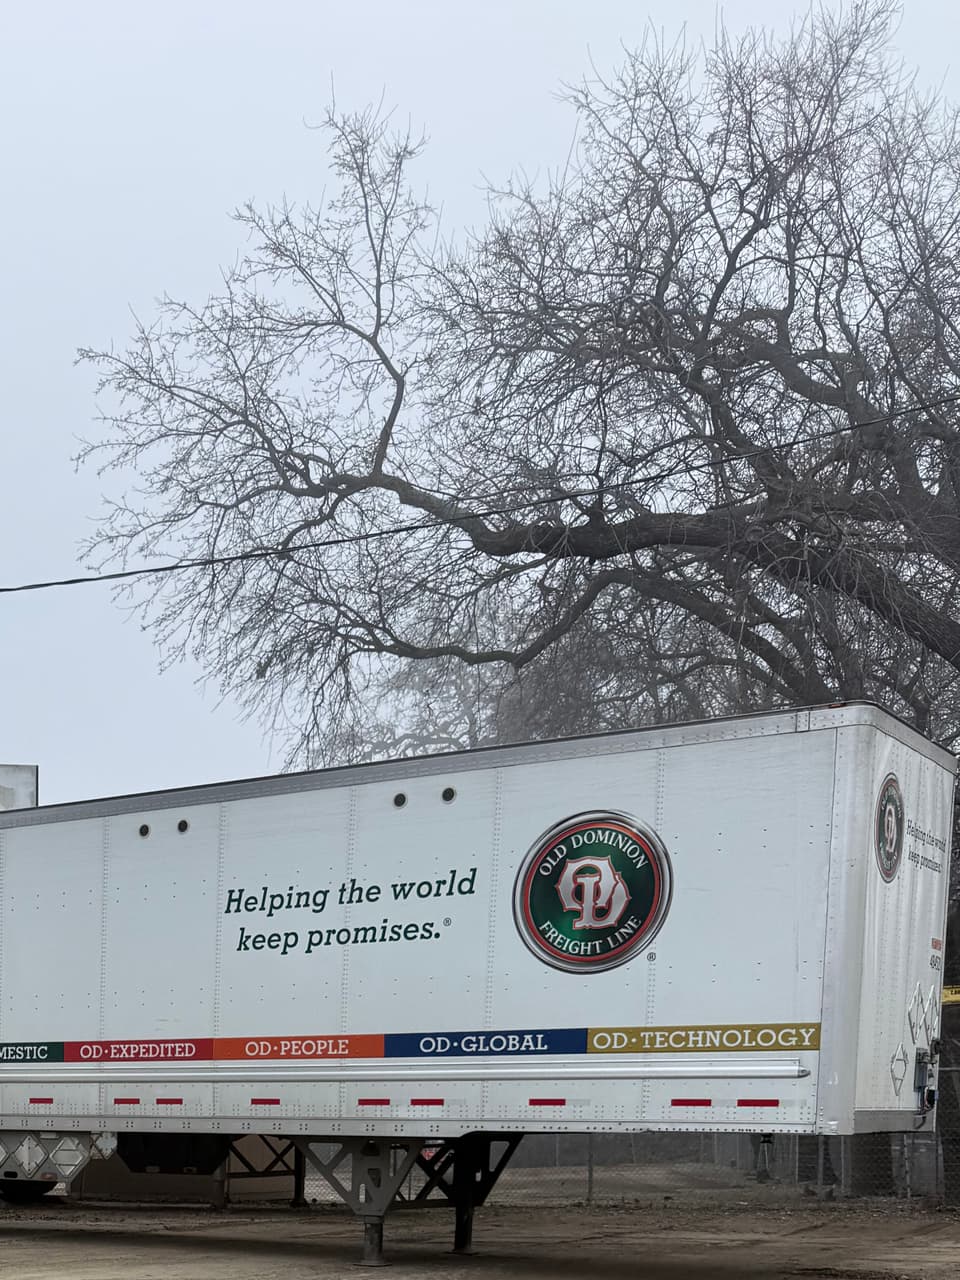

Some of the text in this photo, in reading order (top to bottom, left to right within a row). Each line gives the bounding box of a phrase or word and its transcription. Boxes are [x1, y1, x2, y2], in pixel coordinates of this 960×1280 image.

[539, 829, 649, 876] OLD DOMINION
[225, 868, 478, 917] Helping the world
[236, 927, 299, 955] keep
[539, 915, 642, 955] FREIGHT LINE
